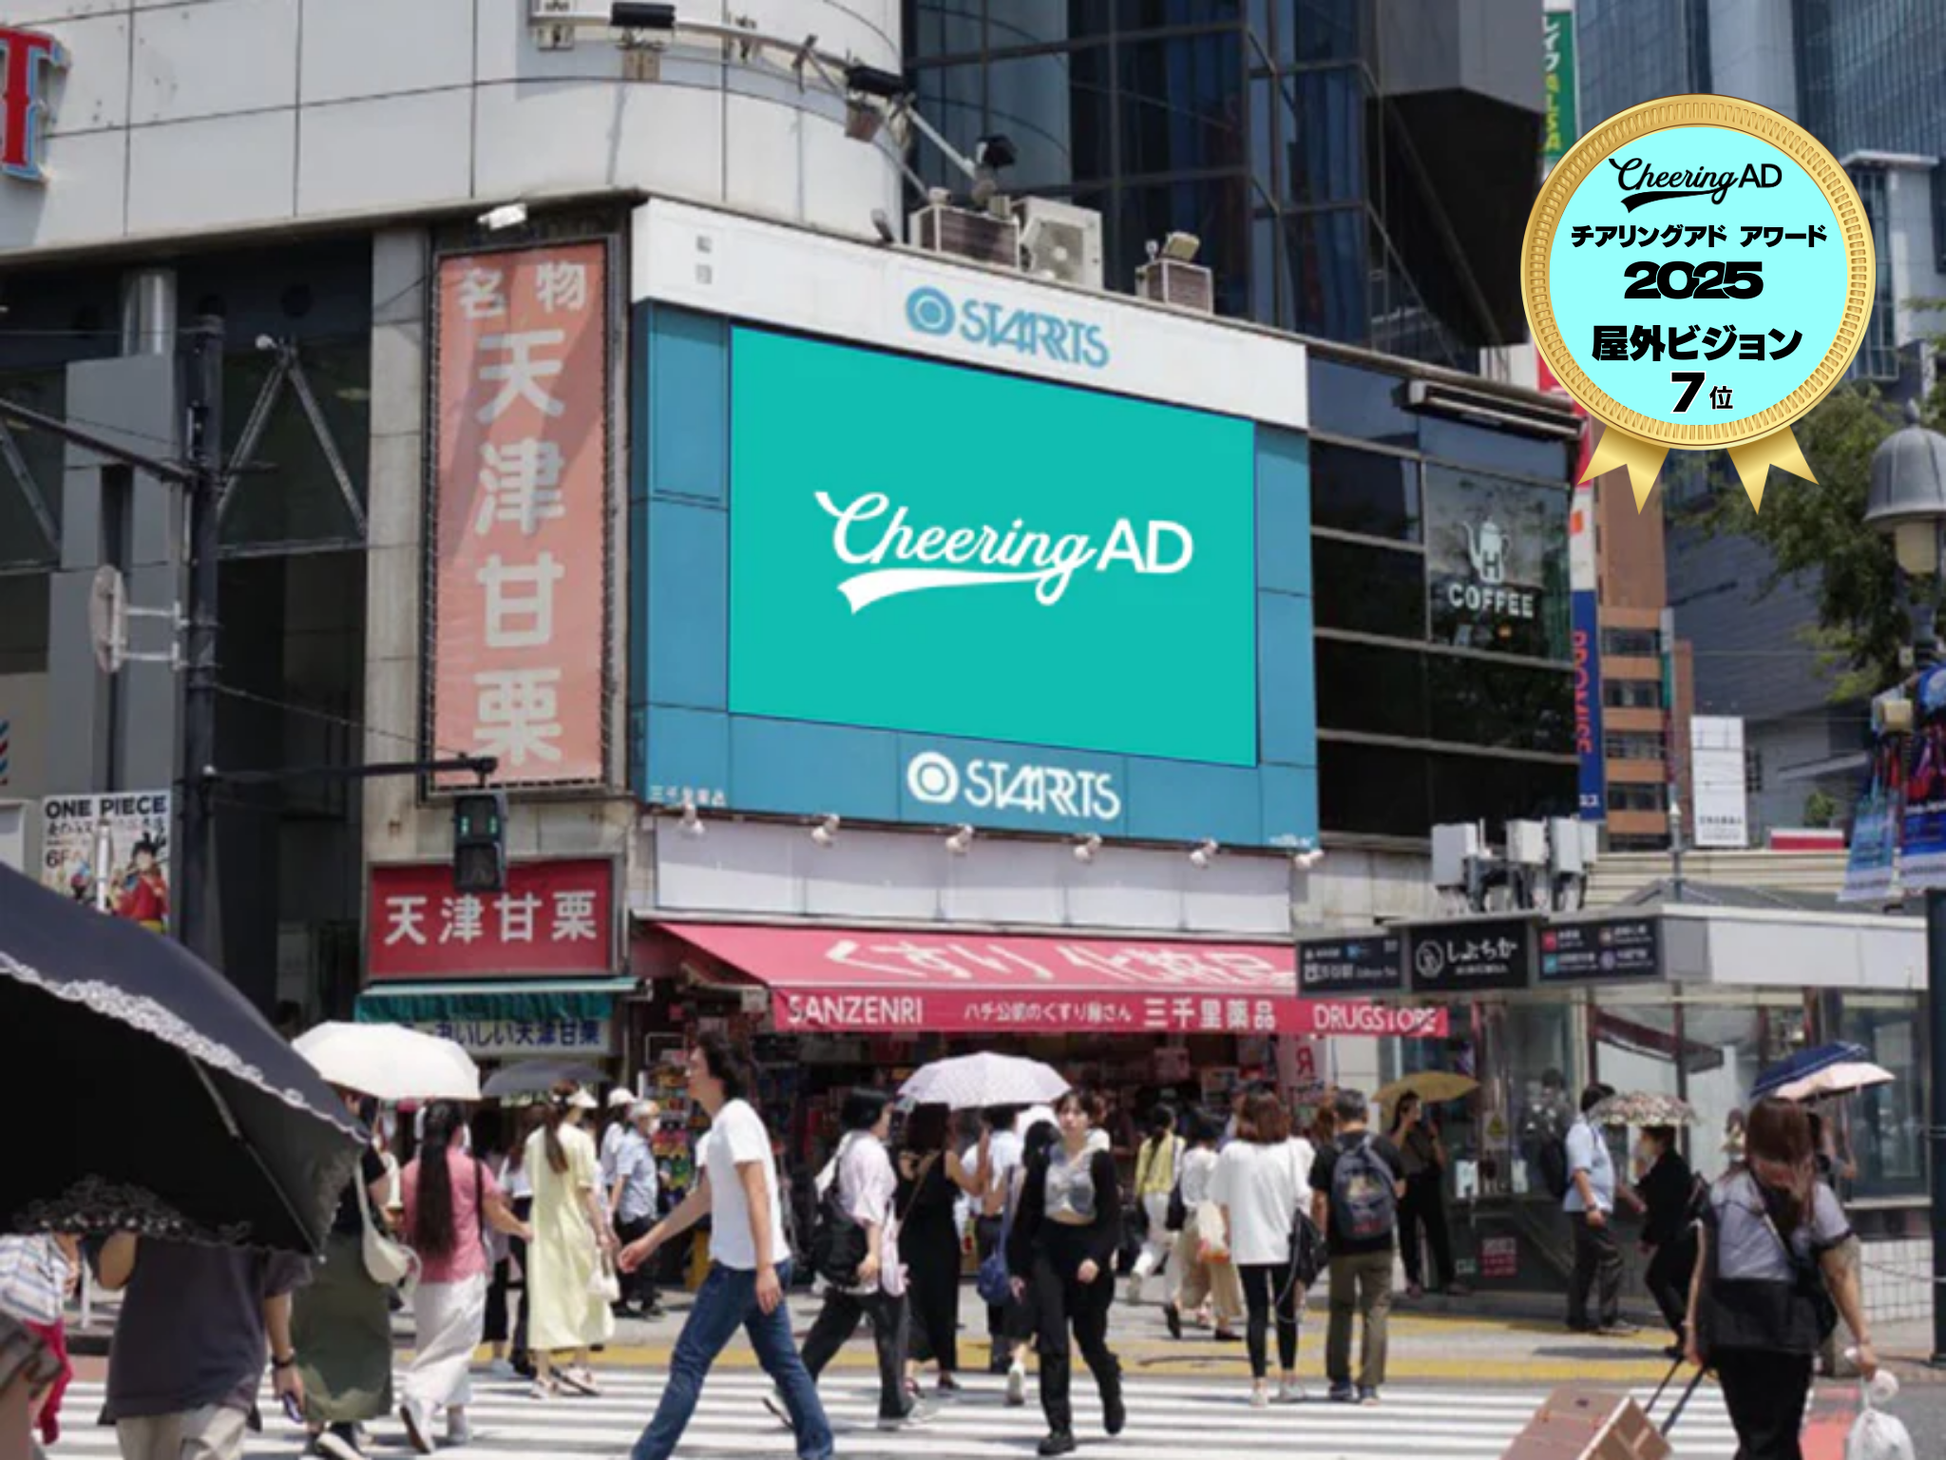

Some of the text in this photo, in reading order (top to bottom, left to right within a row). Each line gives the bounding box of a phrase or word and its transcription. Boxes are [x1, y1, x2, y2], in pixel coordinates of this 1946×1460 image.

[458, 260, 588, 319] 名物
[475, 329, 566, 767] 天津甘栗
[814, 491, 1194, 608] Cheering AD
[1448, 583, 1534, 618] COFFEE
[45, 795, 167, 819] ONE PIECE
[384, 890, 597, 945] 天津甘栗
[825, 940, 1053, 980] くすり
[788, 995, 923, 1026] SANZENRI
[1144, 998, 1276, 1030] 三千里薬品
